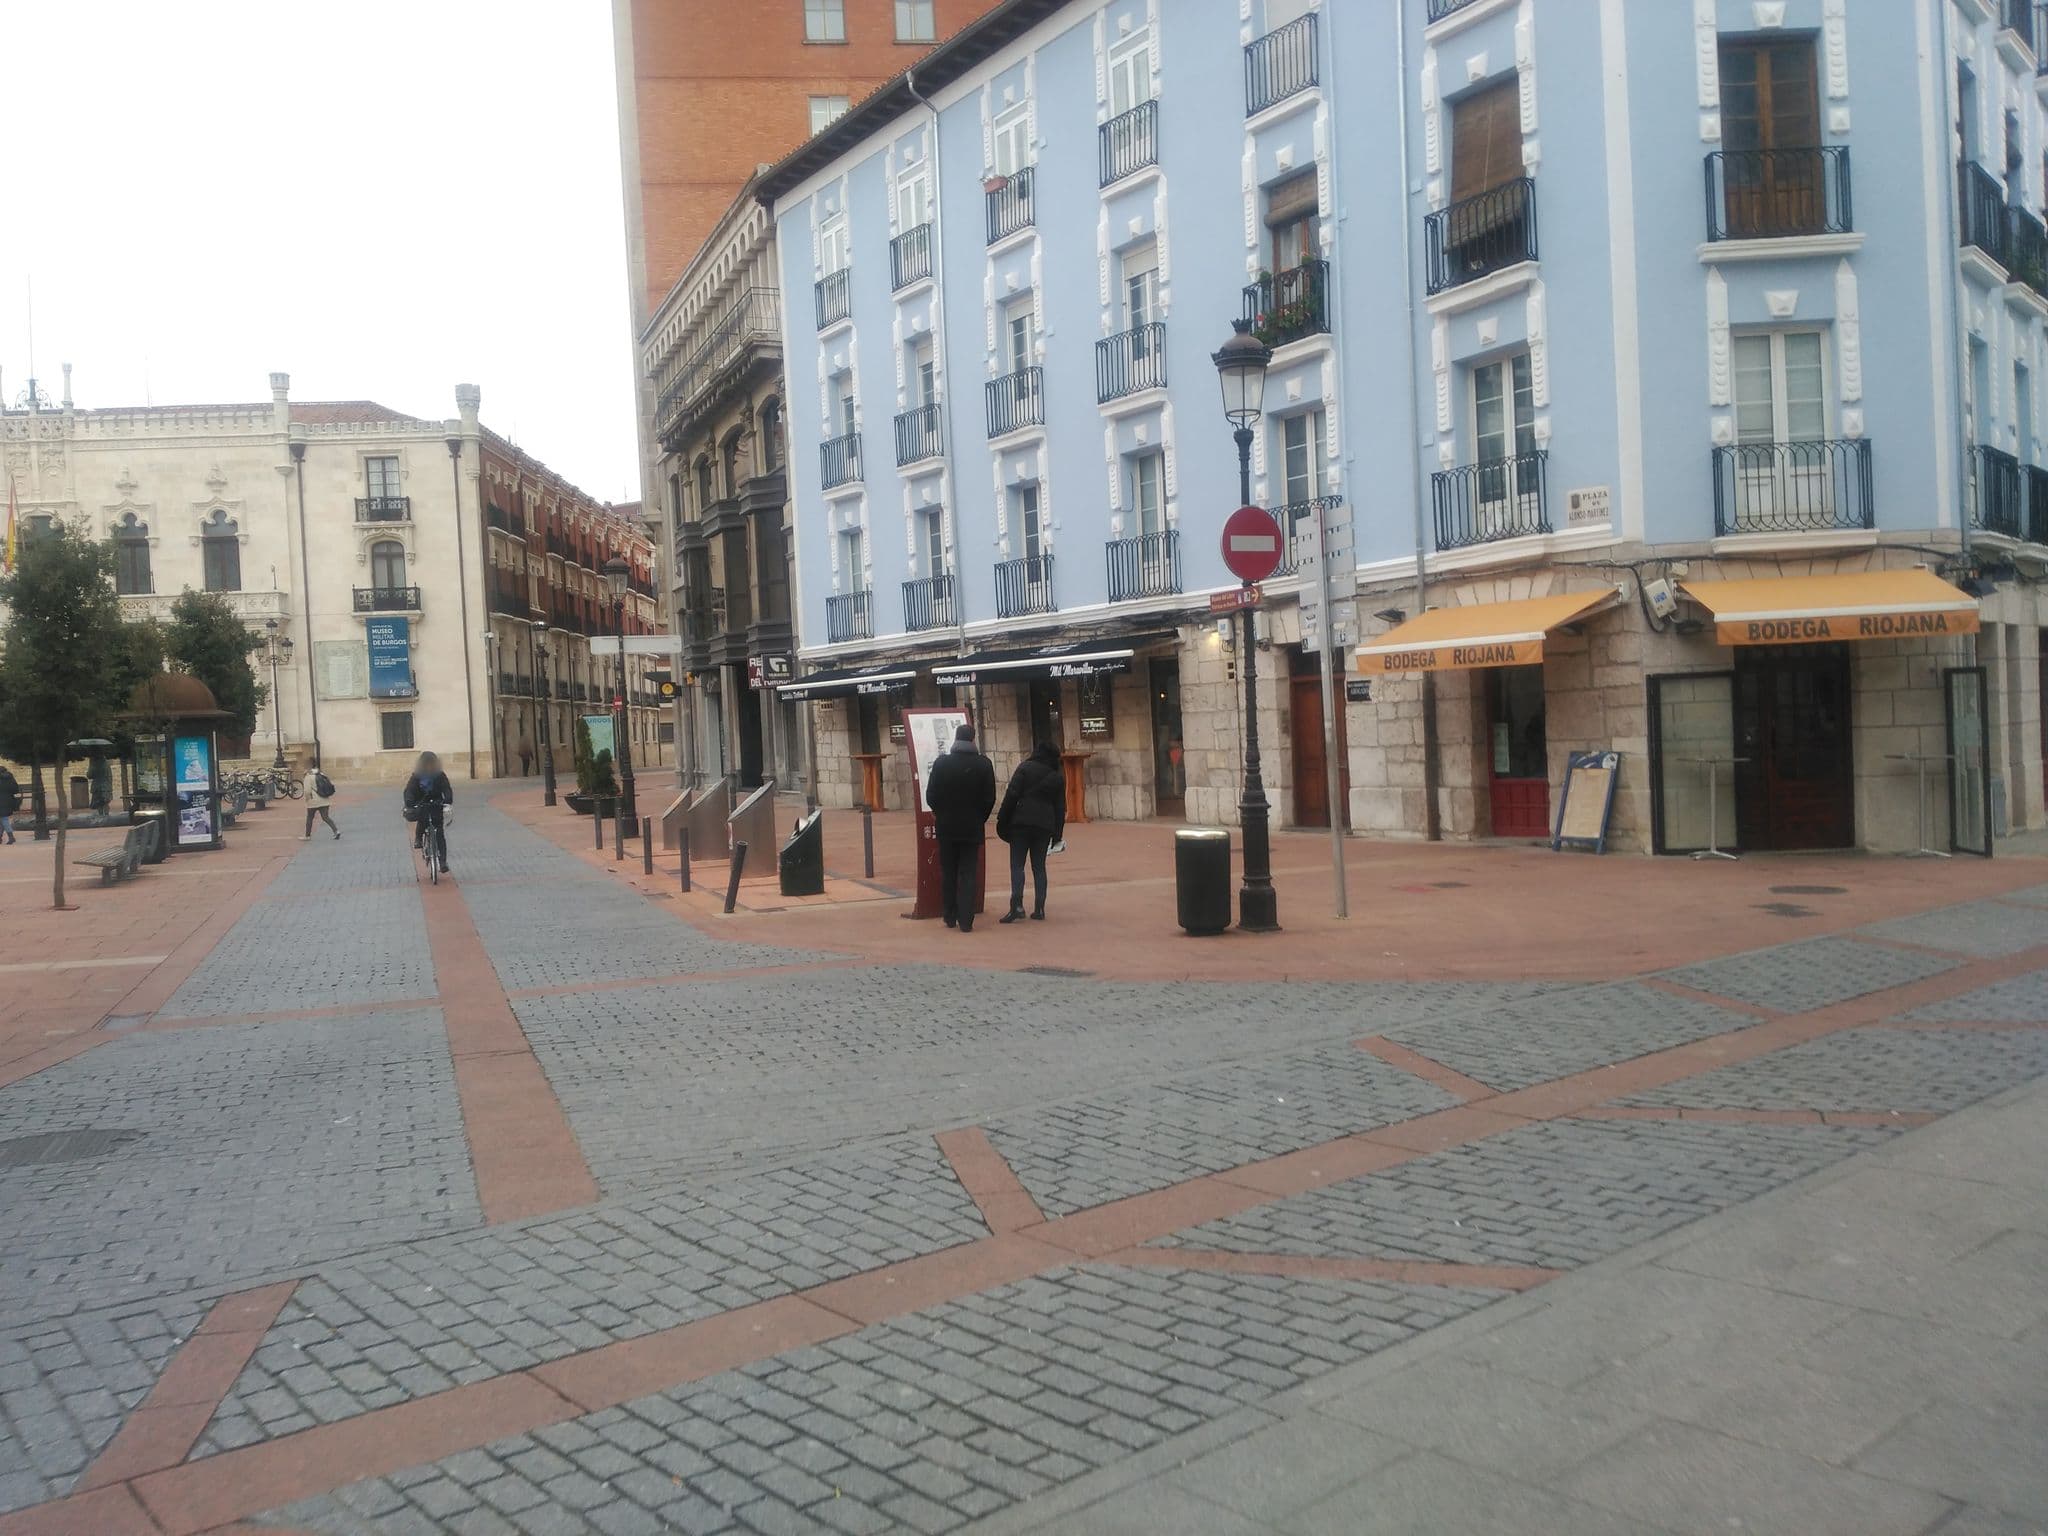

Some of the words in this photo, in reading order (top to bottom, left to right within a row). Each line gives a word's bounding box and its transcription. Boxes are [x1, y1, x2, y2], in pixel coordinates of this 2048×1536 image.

[1582, 490, 1608, 500] PLAZA
[1748, 619, 1831, 641] BODEGA
[1859, 614, 1948, 635] RIOJANA
[1384, 651, 1437, 670] BODEGA
[1453, 645, 1516, 665] RIOJANA
[750, 678, 762, 687] DEL
